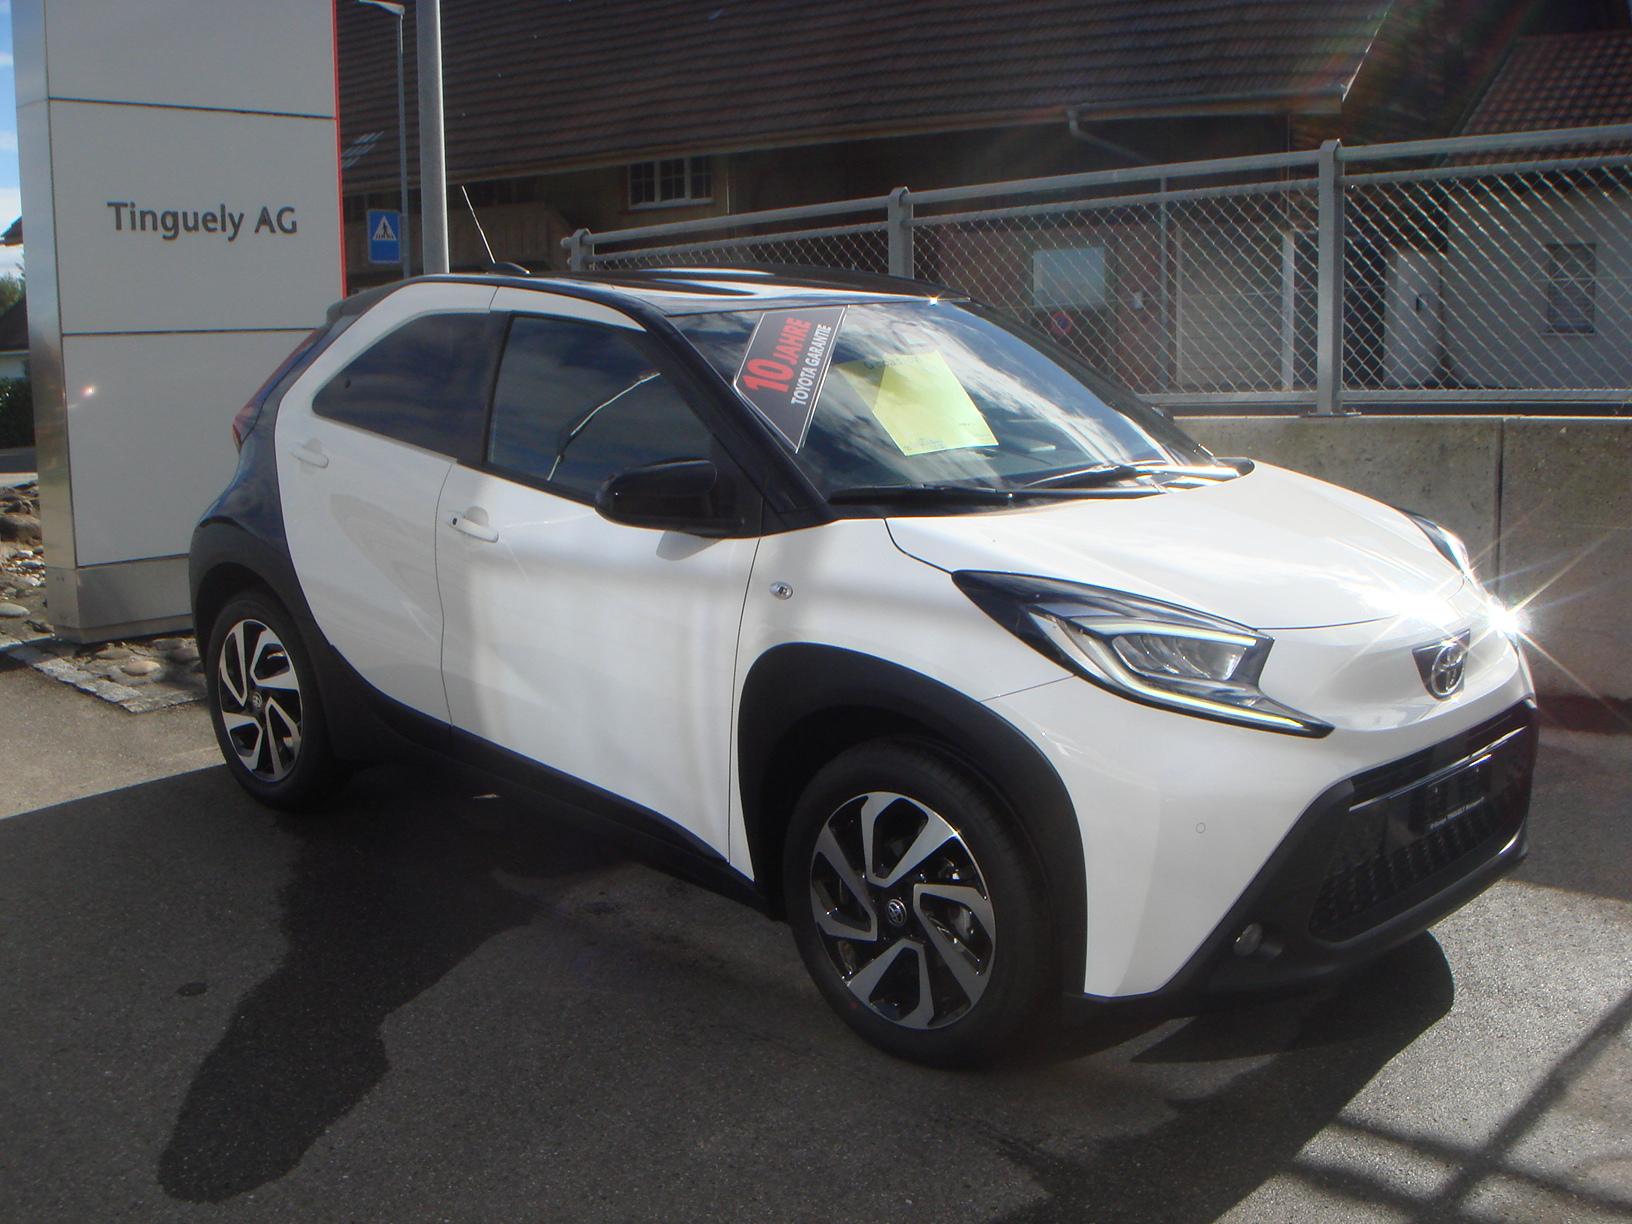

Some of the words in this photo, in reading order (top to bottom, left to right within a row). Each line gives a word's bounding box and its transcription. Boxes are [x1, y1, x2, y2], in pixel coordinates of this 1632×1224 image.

[106, 201, 245, 242] Tinguely
[254, 206, 298, 235] AG
[742, 358, 795, 393] 10
[772, 317, 812, 366] JAHRE
[790, 366, 818, 406] TOYOTA
[804, 323, 832, 368] GARANTIE
